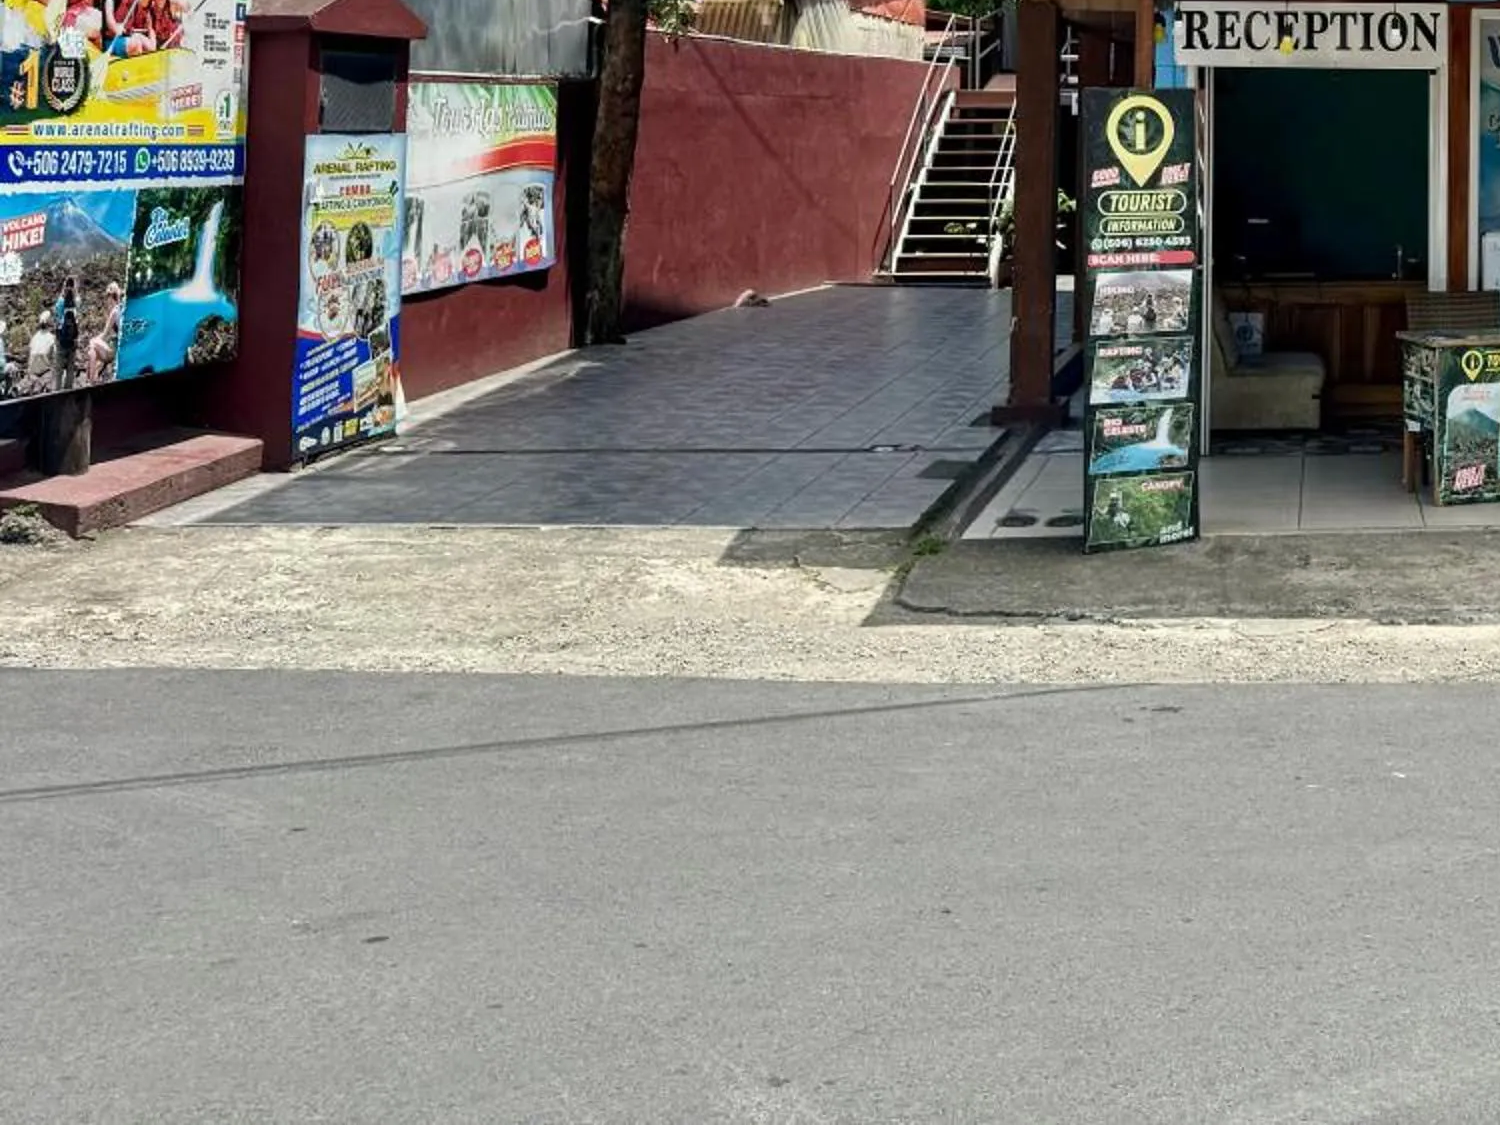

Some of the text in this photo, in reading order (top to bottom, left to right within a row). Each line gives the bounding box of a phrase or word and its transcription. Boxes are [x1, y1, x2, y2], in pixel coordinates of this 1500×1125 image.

[1181, 10, 1441, 52] RECEPTION
[33, 123, 185, 140] www.arenalrafting.com
[25, 149, 128, 176] +506 2479-7215
[152, 150, 179, 172] +506
[1108, 194, 1175, 212] TOURIST
[3, 213, 47, 233] VOLCANO
[1107, 218, 1177, 232] INFORMATION
[1, 225, 46, 252] HIKE!
